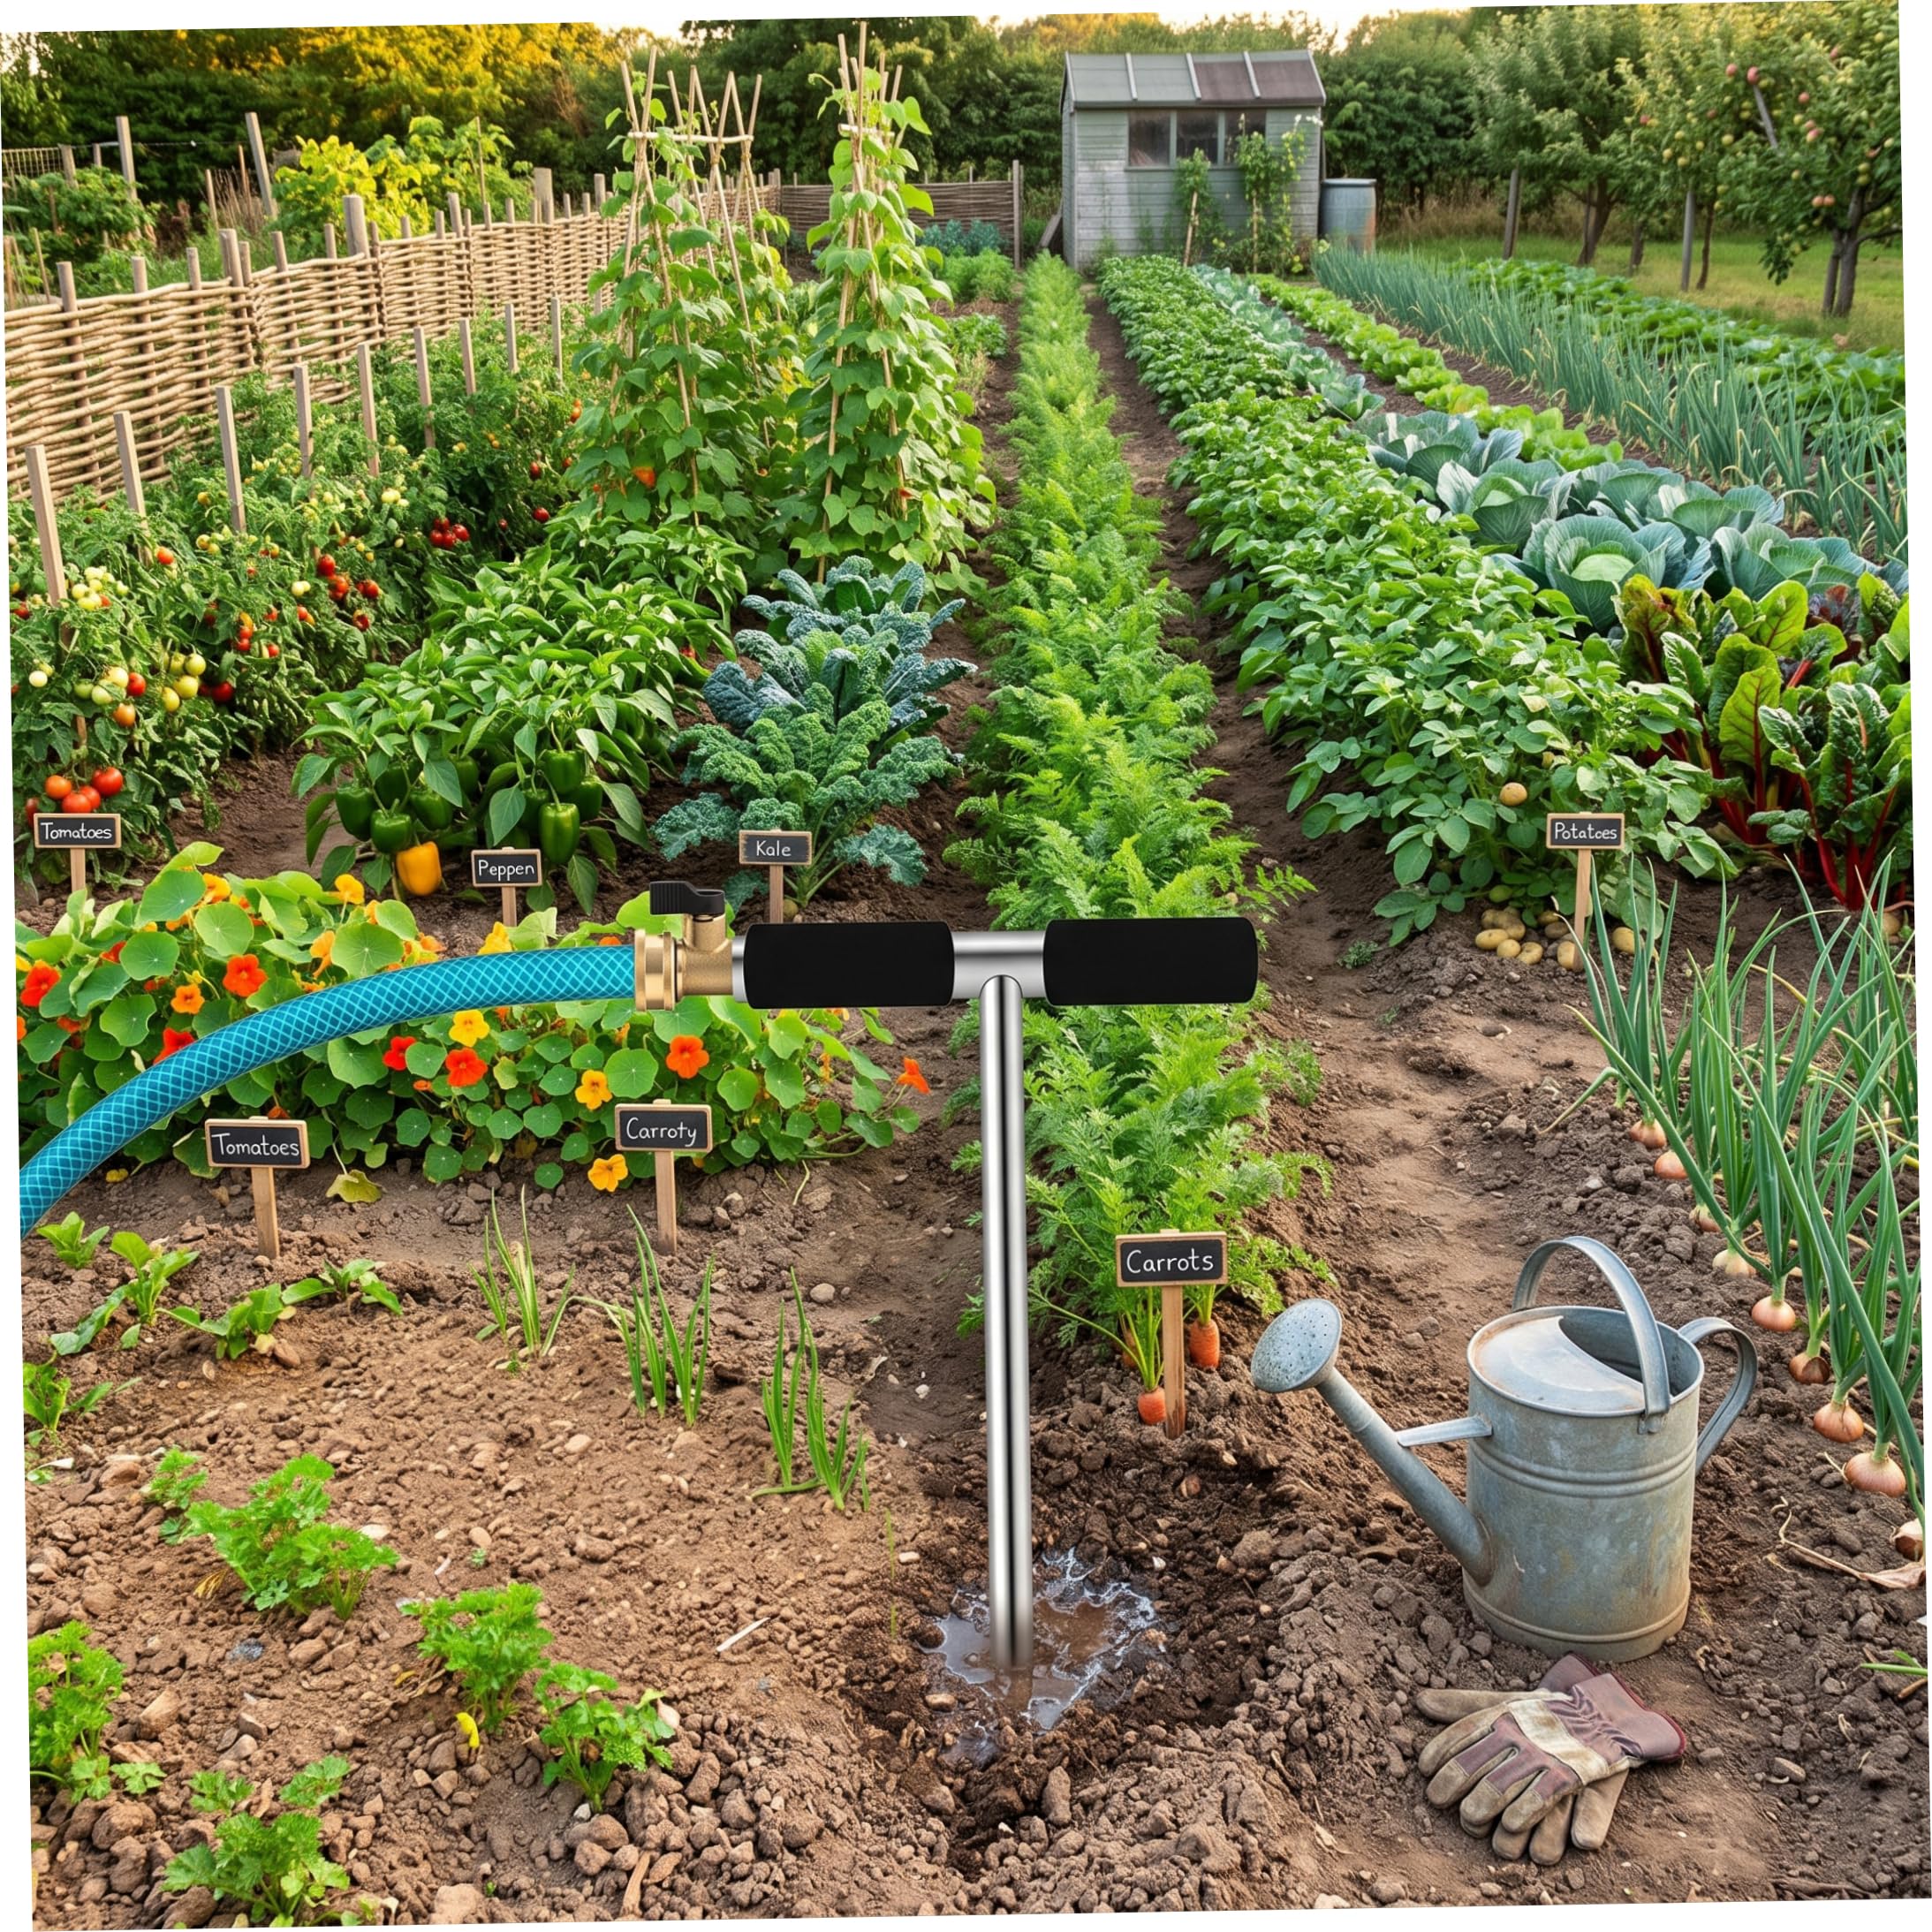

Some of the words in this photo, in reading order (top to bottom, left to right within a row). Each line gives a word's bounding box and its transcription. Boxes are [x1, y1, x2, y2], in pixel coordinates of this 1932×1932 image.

[40, 822, 112, 841] Tomatoes
[756, 840, 792, 857] Kale
[478, 859, 535, 883] Peppen
[210, 1132, 299, 1156] Tomatoes
[625, 1117, 697, 1148] Carroty
[1126, 1247, 1215, 1274] Carrots
